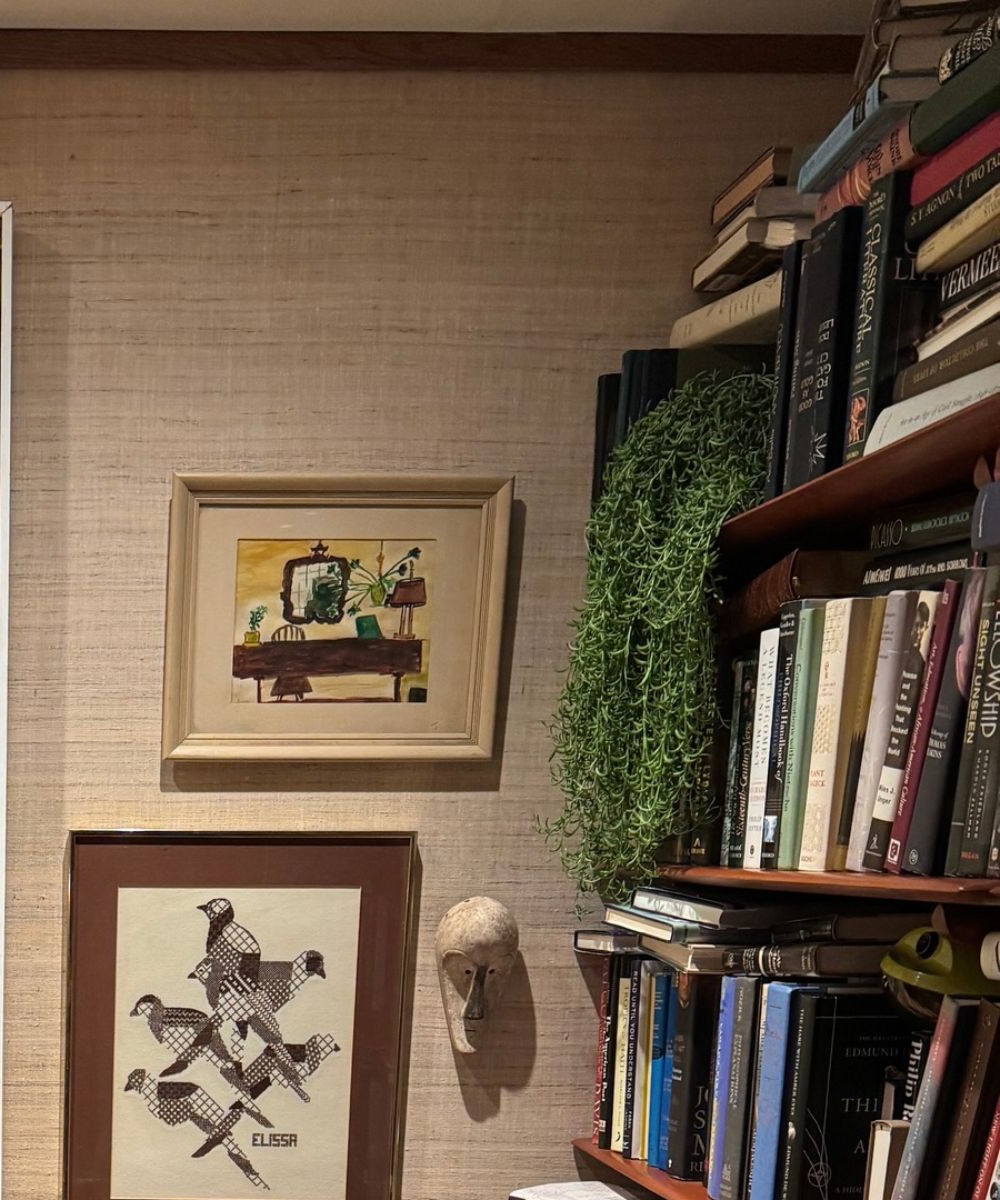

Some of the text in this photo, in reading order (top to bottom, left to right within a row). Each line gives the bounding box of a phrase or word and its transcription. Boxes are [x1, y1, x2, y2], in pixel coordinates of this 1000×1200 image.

[861, 223, 882, 340] CLASSICAL
[757, 663, 767, 719] LEGEND
[966, 619, 990, 744] SIGHT UNSEEN
[760, 646, 776, 765] WHAT BECOMES
[790, 664, 802, 736] Conversations
[774, 653, 794, 783] The Oxford Handbook of
[753, 725, 763, 769] MOST
[896, 786, 910, 816] Culture
[631, 971, 639, 993] READ
[604, 1015, 612, 1034] The
[629, 996, 637, 1021] UNTIL
[601, 1036, 610, 1079] American
[619, 1044, 627, 1074] HAITI
[845, 1048, 899, 1057] EDMUND
[626, 1046, 635, 1100] UNDERSTAND
[791, 1070, 799, 1097] AMBER
[252, 1133, 298, 1148] ELISSA
[979, 1136, 995, 1169] LIGHT
[783, 1145, 791, 1175] EDMUND
